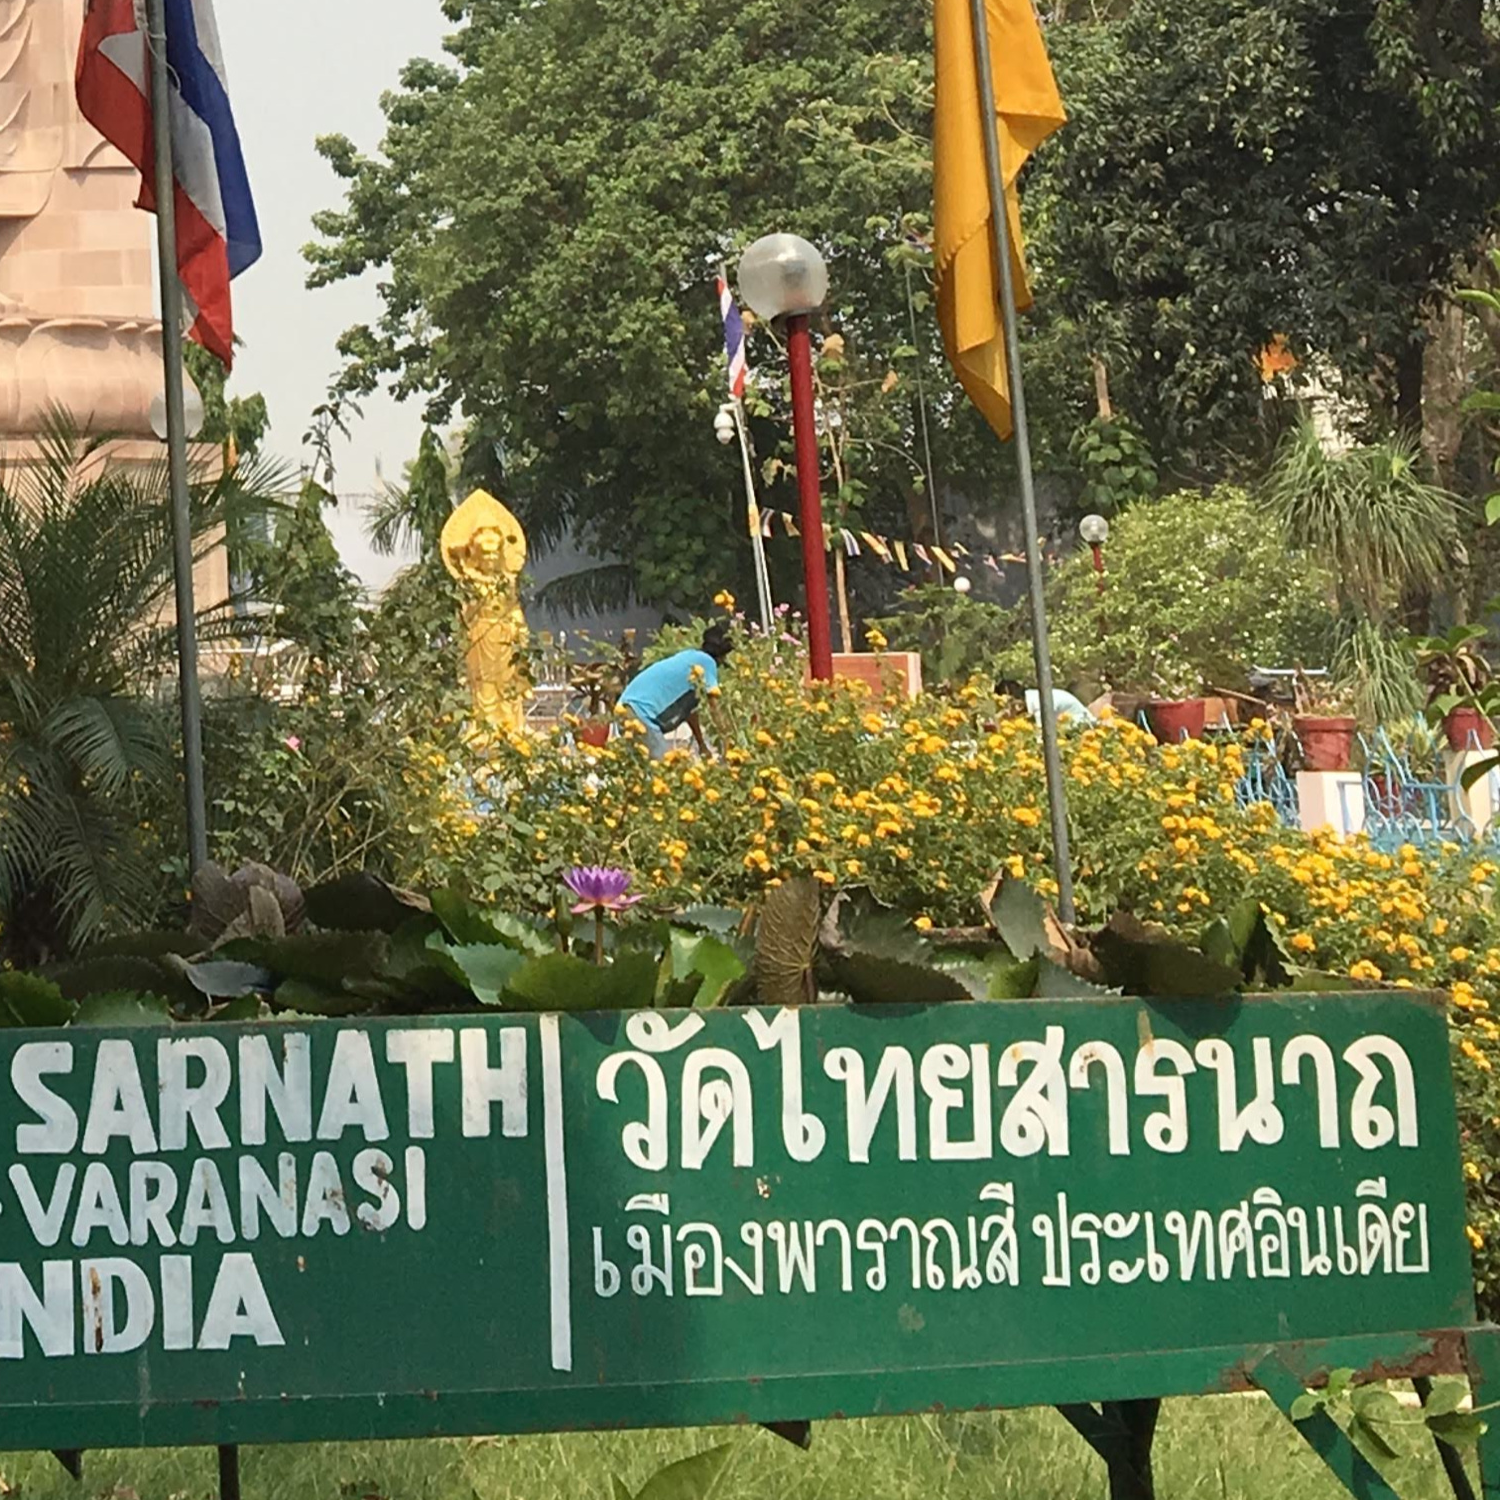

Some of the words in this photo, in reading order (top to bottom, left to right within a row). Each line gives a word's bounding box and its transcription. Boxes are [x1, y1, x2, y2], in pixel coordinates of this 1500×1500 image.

[10, 1026, 528, 1155] SARNATH
[595, 1006, 1419, 1172] วัดไทยสารนาถ
[592, 1181, 1020, 1297] เมืองพาราณสี
[1032, 1176, 1430, 1287] ประเทศอินเดีย
